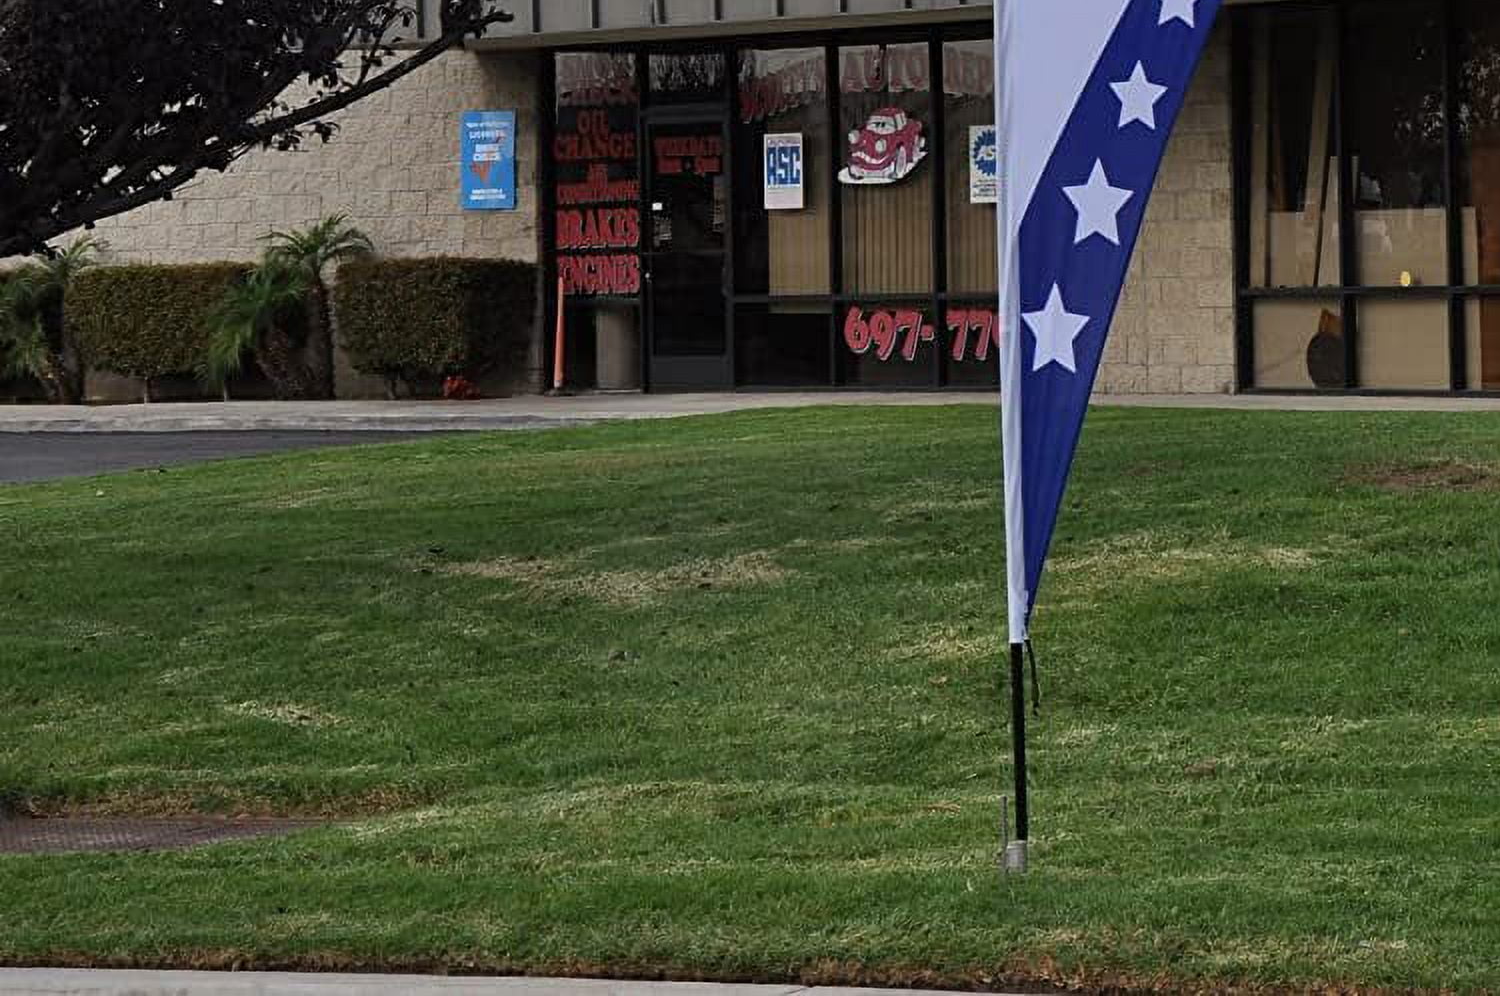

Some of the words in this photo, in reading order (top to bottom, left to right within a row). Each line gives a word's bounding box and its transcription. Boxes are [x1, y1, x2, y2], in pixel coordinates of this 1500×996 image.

[577, 109, 608, 135] OIL
[555, 133, 635, 158] CHANGE
[556, 208, 639, 248] BRAKES
[557, 255, 640, 294] ENGINES
